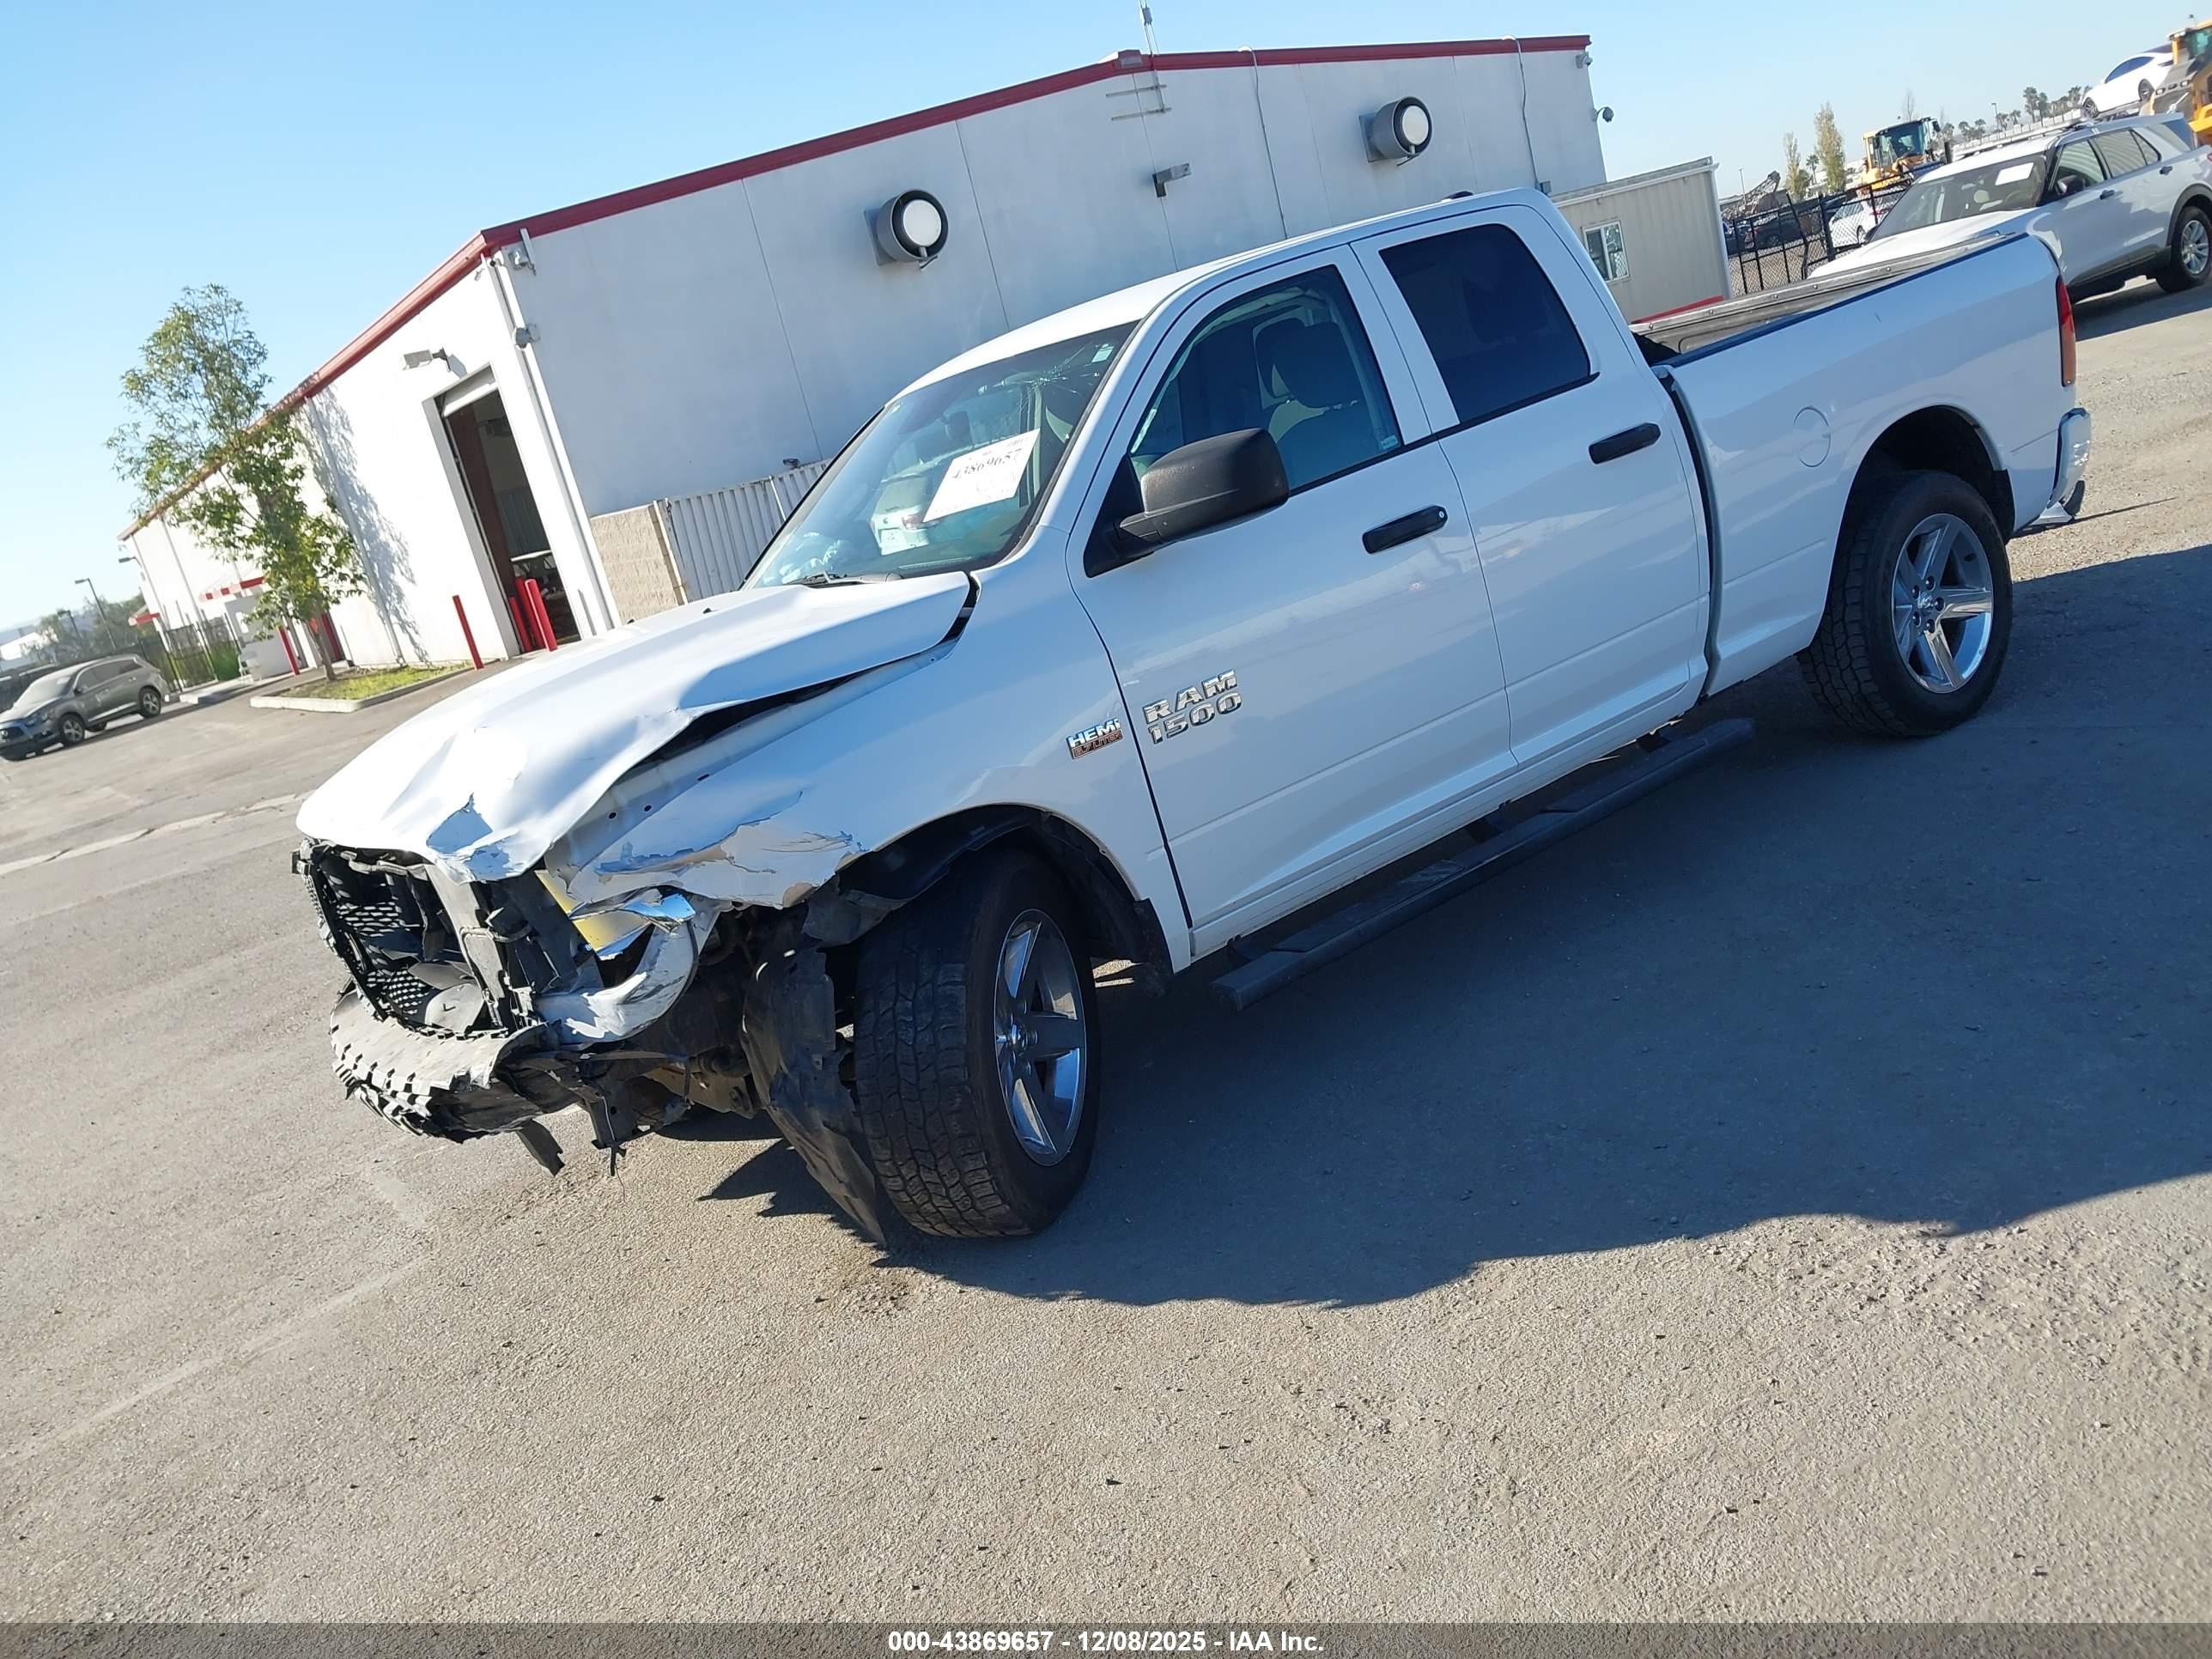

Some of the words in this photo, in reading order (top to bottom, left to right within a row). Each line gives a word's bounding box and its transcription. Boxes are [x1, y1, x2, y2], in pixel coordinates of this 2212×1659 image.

[1144, 670, 1237, 724] RAM
[1150, 693, 1242, 744] 1500
[1066, 718, 1121, 747] HEMI
